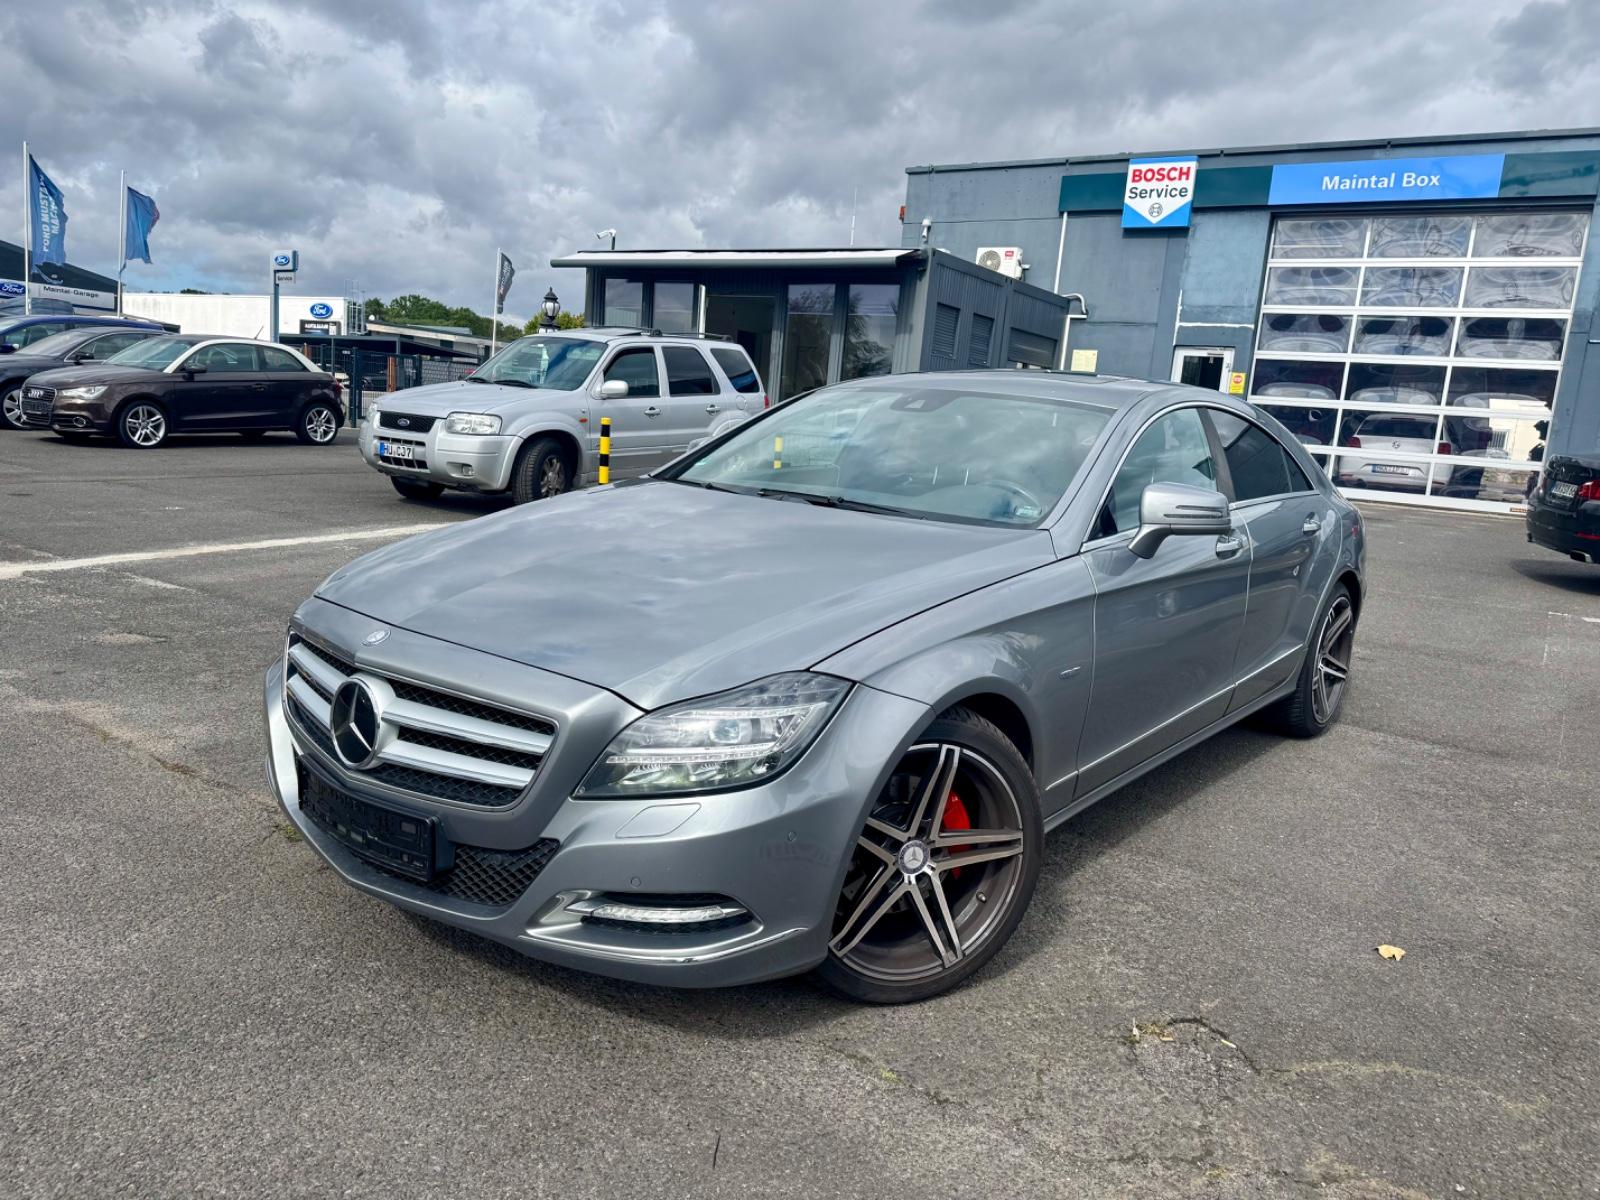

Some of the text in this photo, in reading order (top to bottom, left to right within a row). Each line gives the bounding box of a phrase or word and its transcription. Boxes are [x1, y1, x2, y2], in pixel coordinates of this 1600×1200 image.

[1131, 166, 1191, 183] BOSCH
[1321, 172, 1440, 191] Maintal Box
[1128, 185, 1189, 199] Service
[1, 283, 25, 293] Ford
